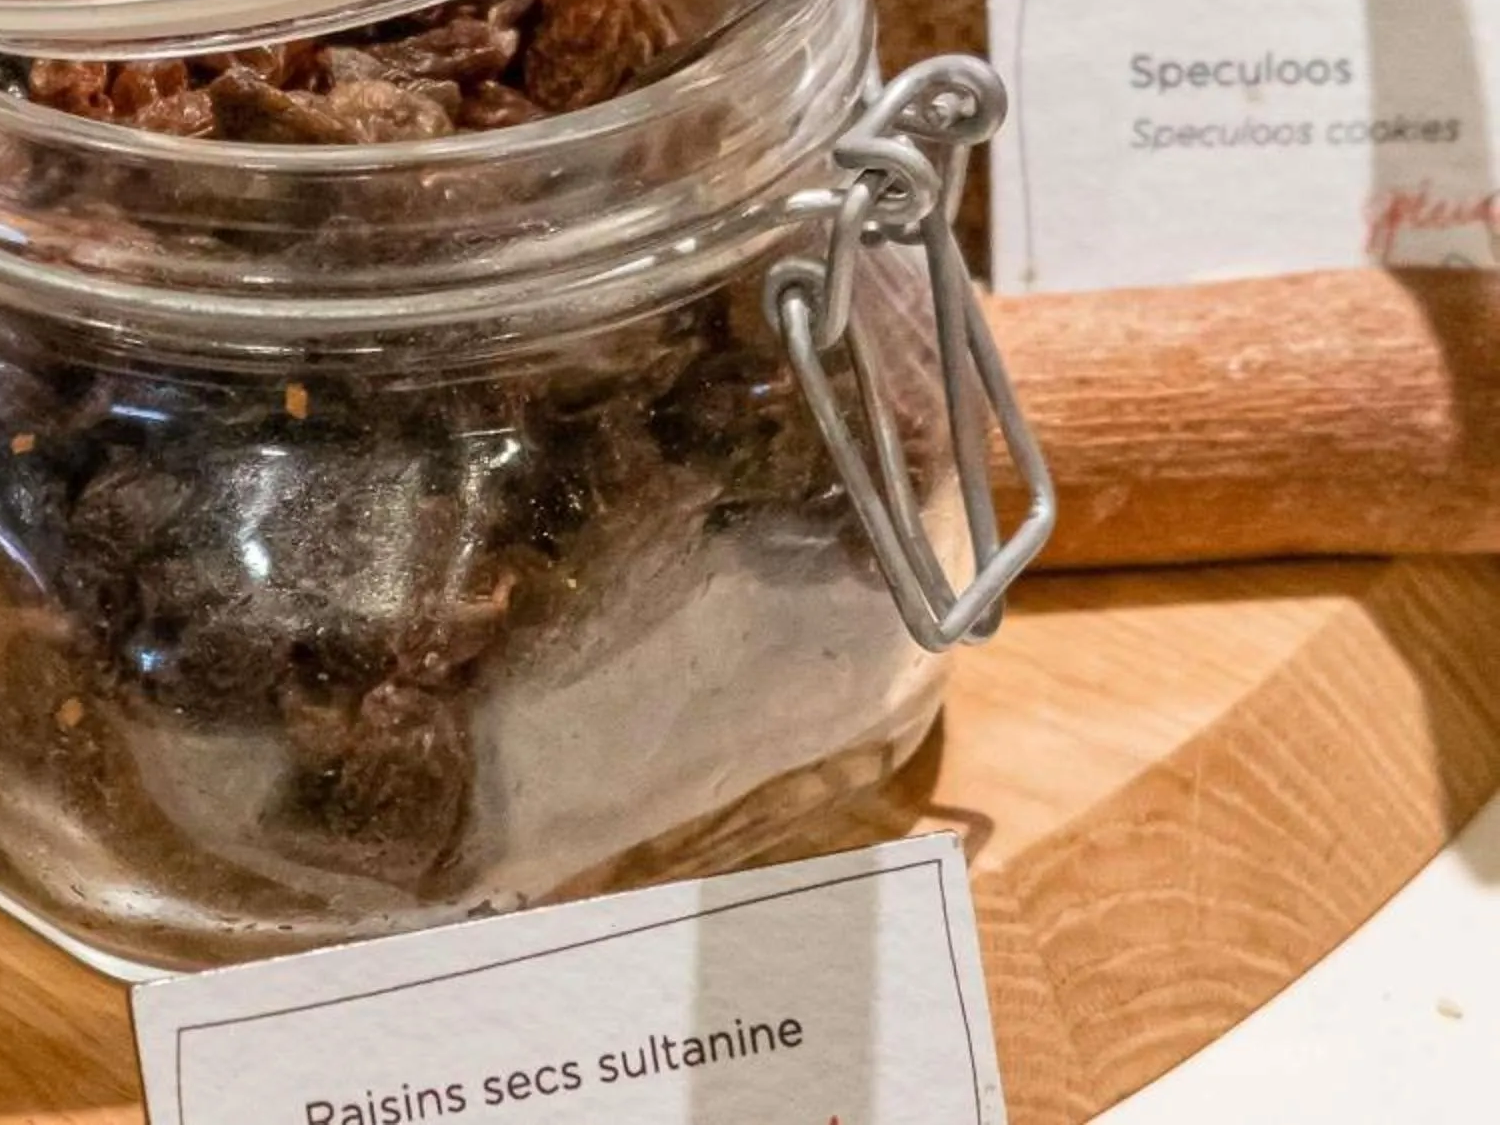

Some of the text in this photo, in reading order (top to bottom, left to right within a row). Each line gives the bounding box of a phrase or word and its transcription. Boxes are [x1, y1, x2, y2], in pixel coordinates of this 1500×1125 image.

[1129, 51, 1353, 94] Speculoos
[1129, 114, 1461, 150] Speculoos cookies
[304, 1016, 804, 1125] Raisins secs sultanine
